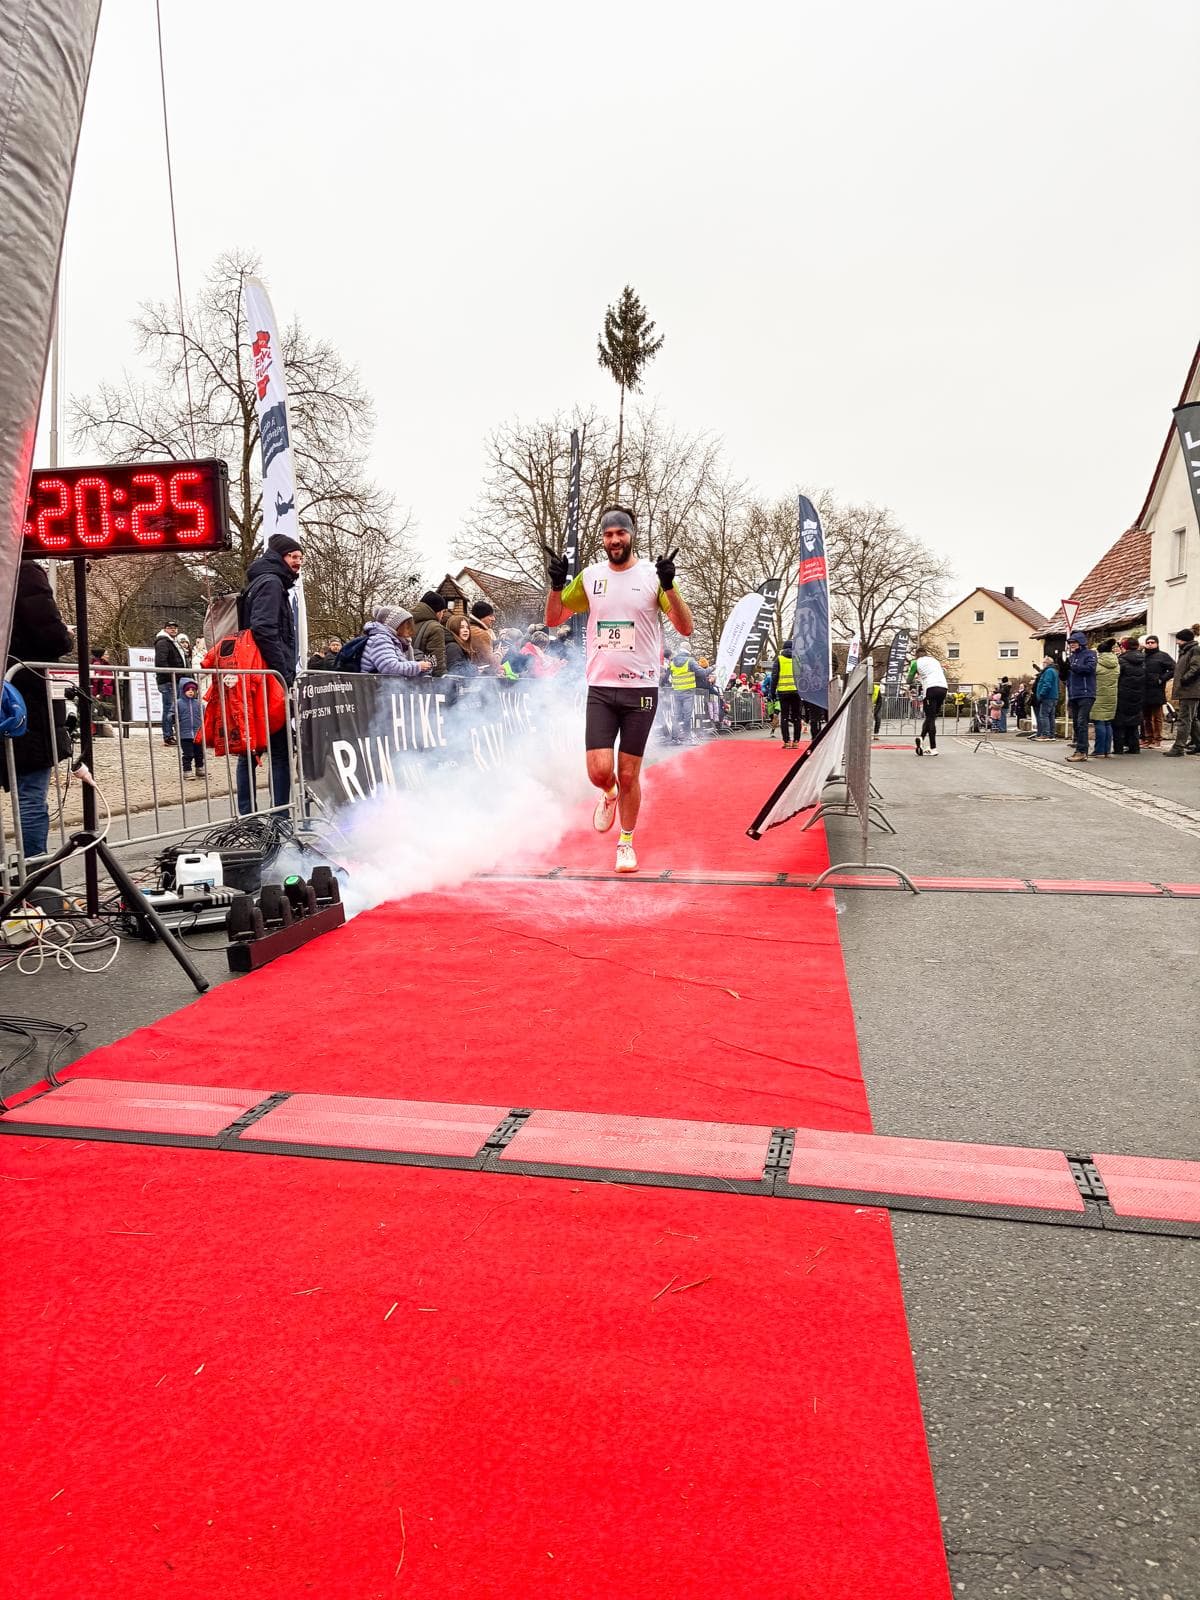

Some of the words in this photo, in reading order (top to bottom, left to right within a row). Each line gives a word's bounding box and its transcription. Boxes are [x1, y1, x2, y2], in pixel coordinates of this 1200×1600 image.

[608, 628, 621, 640] 26
[391, 693, 448, 752] HIKE
[332, 735, 397, 803] RUN
